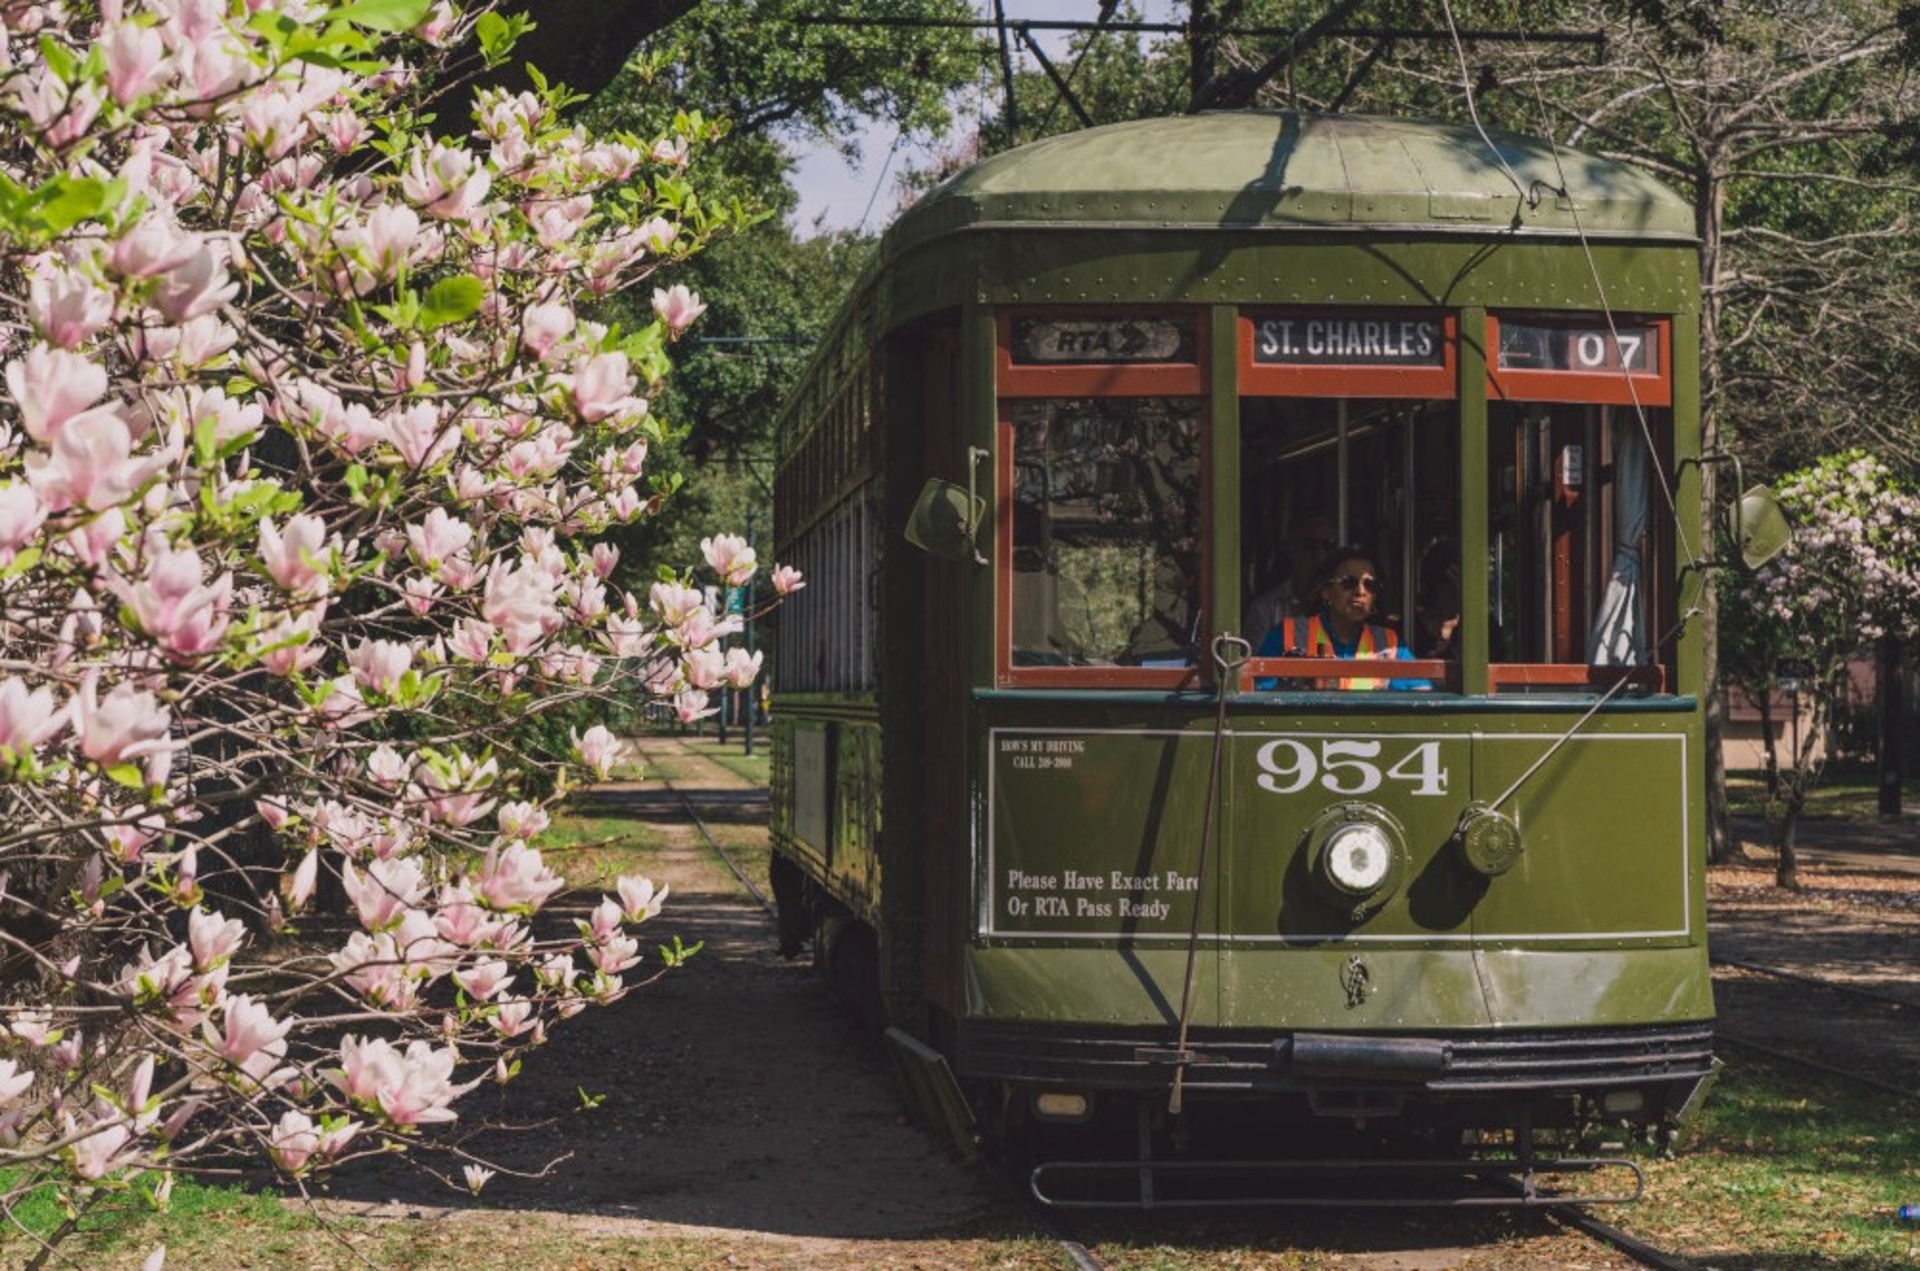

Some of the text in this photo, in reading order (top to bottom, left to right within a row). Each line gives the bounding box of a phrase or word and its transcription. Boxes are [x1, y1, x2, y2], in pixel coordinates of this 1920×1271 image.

[1056, 330, 1110, 352] RTA
[1262, 320, 1433, 357] ST. CHARLES
[1577, 332, 1642, 372] 07
[1013, 756, 1036, 769] CALL
[1256, 738, 1450, 796] 954
[1007, 869, 1058, 890] Please
[1063, 870, 1105, 890] Have
[1111, 871, 1160, 891] Exact
[1007, 896, 1171, 921] Or RTA Pass Ready
